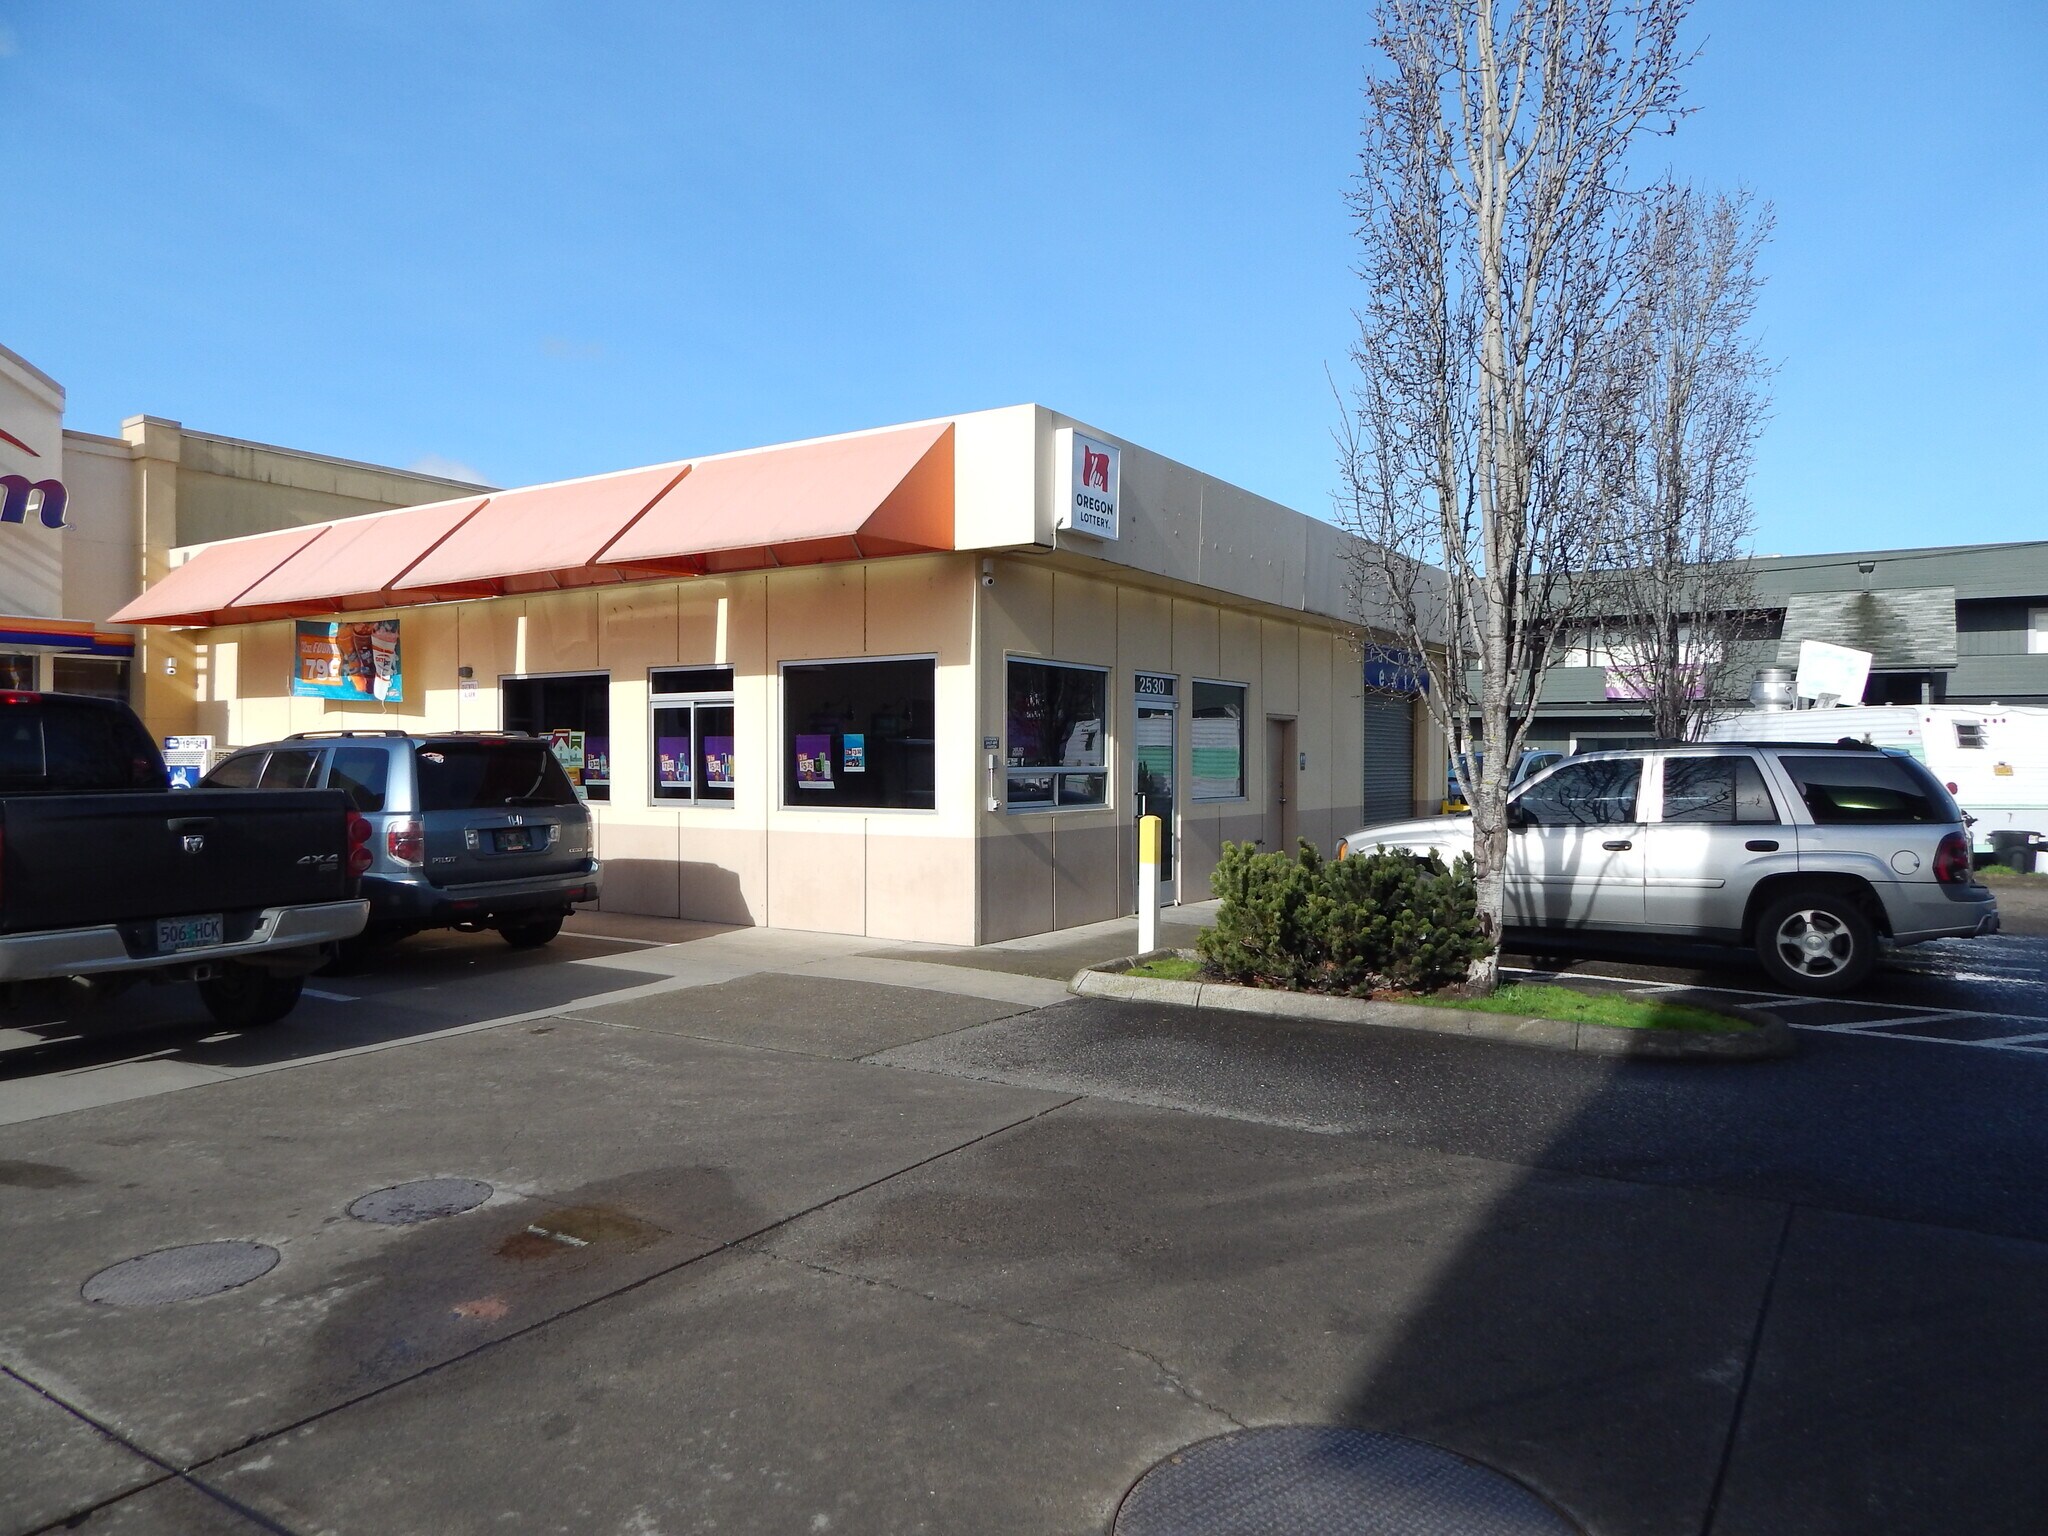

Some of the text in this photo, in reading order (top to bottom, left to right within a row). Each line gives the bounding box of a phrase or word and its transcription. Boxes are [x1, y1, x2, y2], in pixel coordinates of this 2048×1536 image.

[1076, 493, 1113, 516] OREGON
[1139, 676, 1165, 694] 2530
[160, 921, 220, 943] 506 HCK
